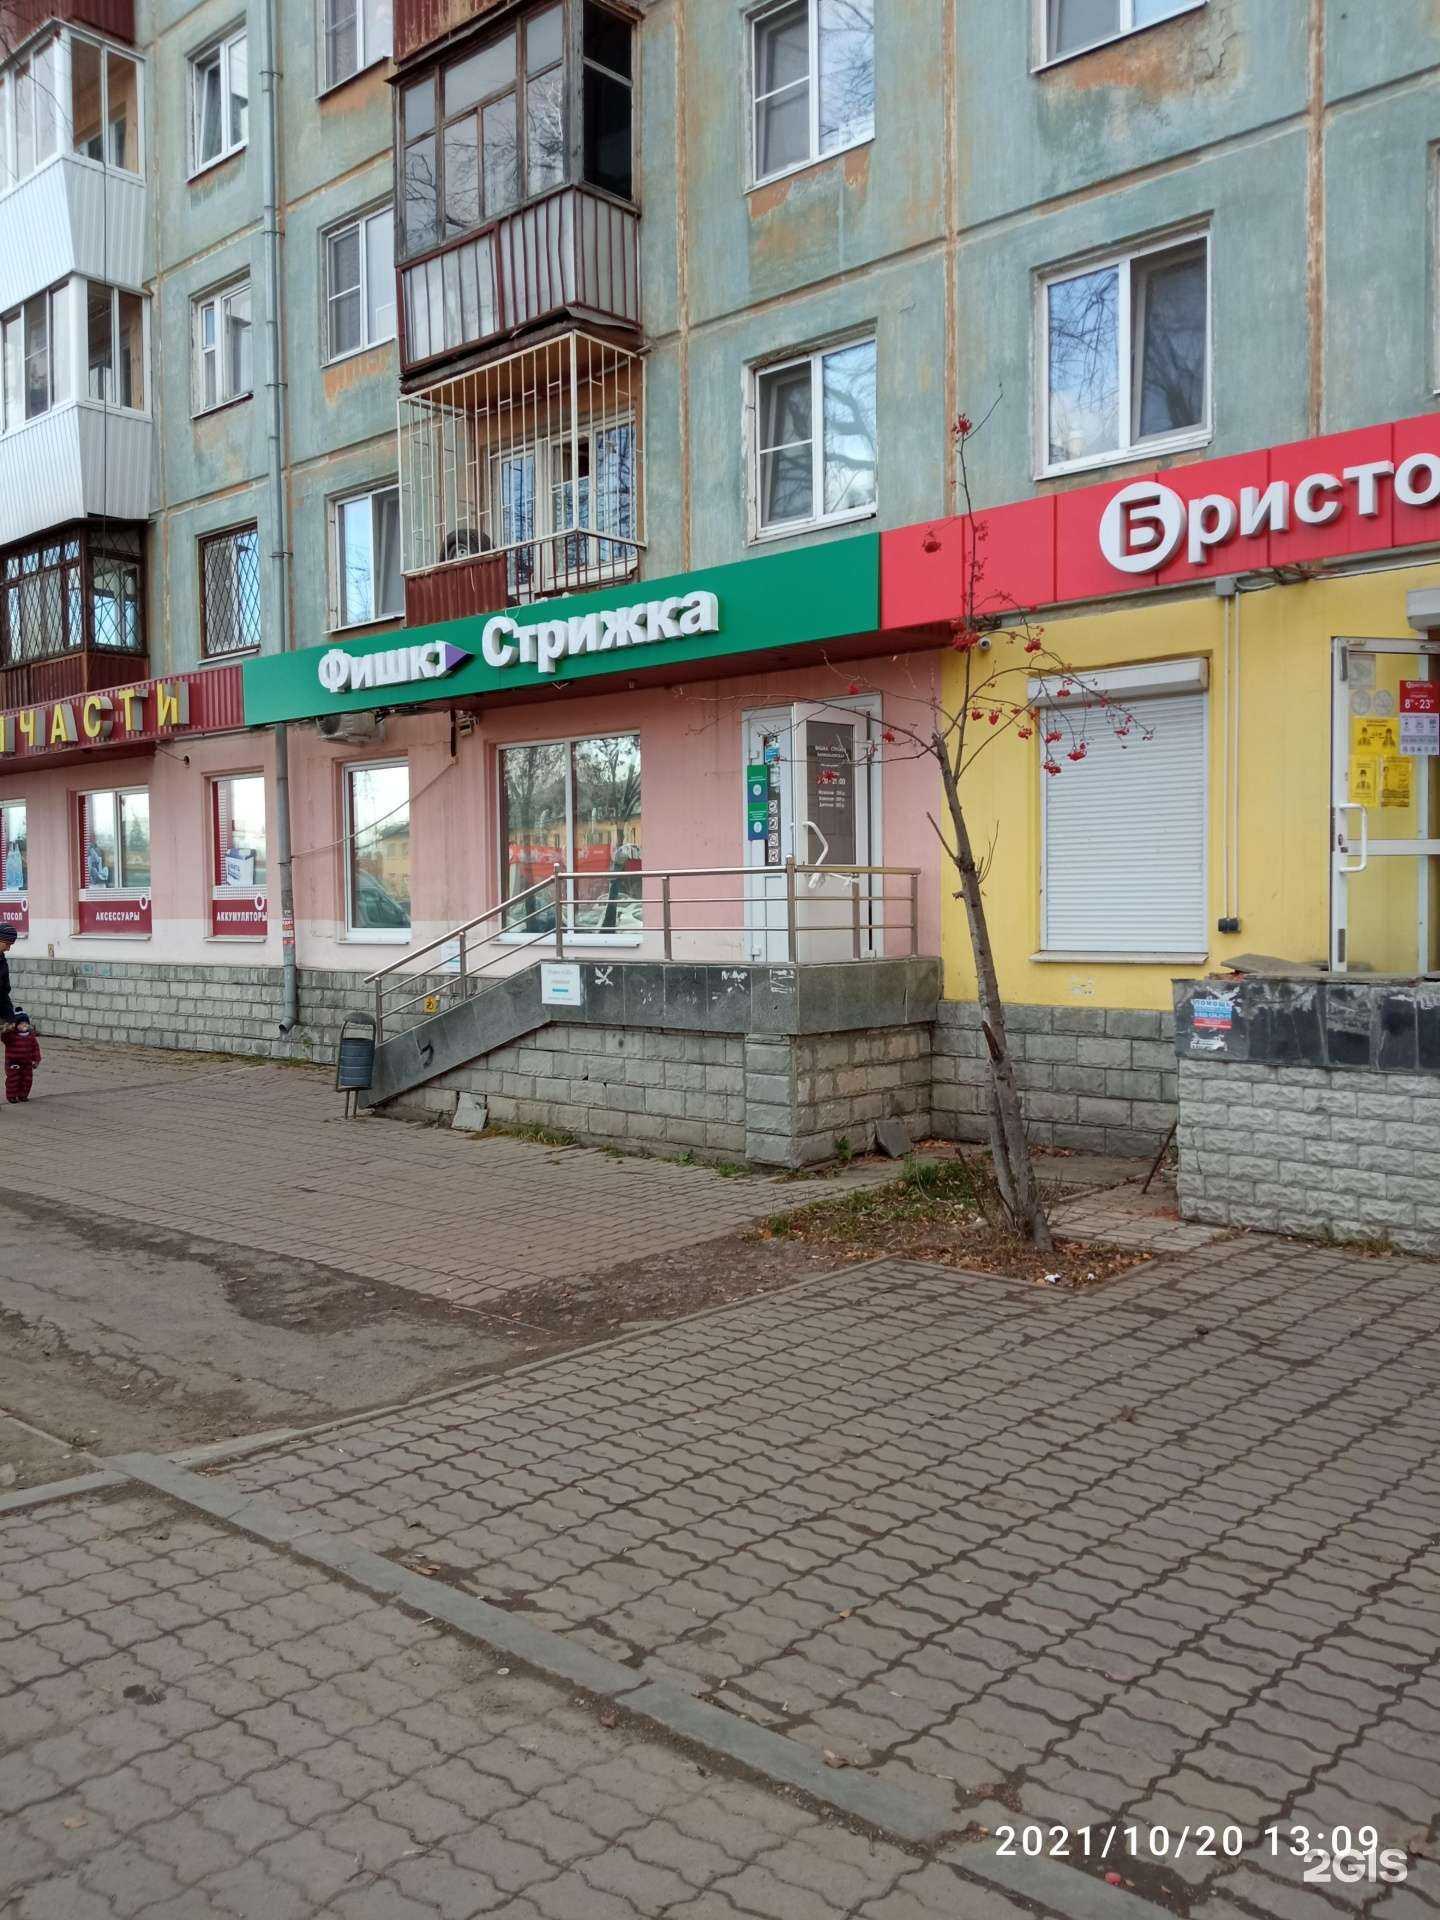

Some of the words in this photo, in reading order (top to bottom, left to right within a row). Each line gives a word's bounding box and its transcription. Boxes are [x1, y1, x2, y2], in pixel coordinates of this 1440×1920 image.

[481, 590, 719, 673] Стрижка
[0, 681, 190, 752] ЧАСТИ
[3, 911, 23, 921] ТОСОЛ
[95, 911, 140, 921] АКСЕССУАРЫ
[216, 911, 268, 921] АККУМУЛЯТОРЫ
